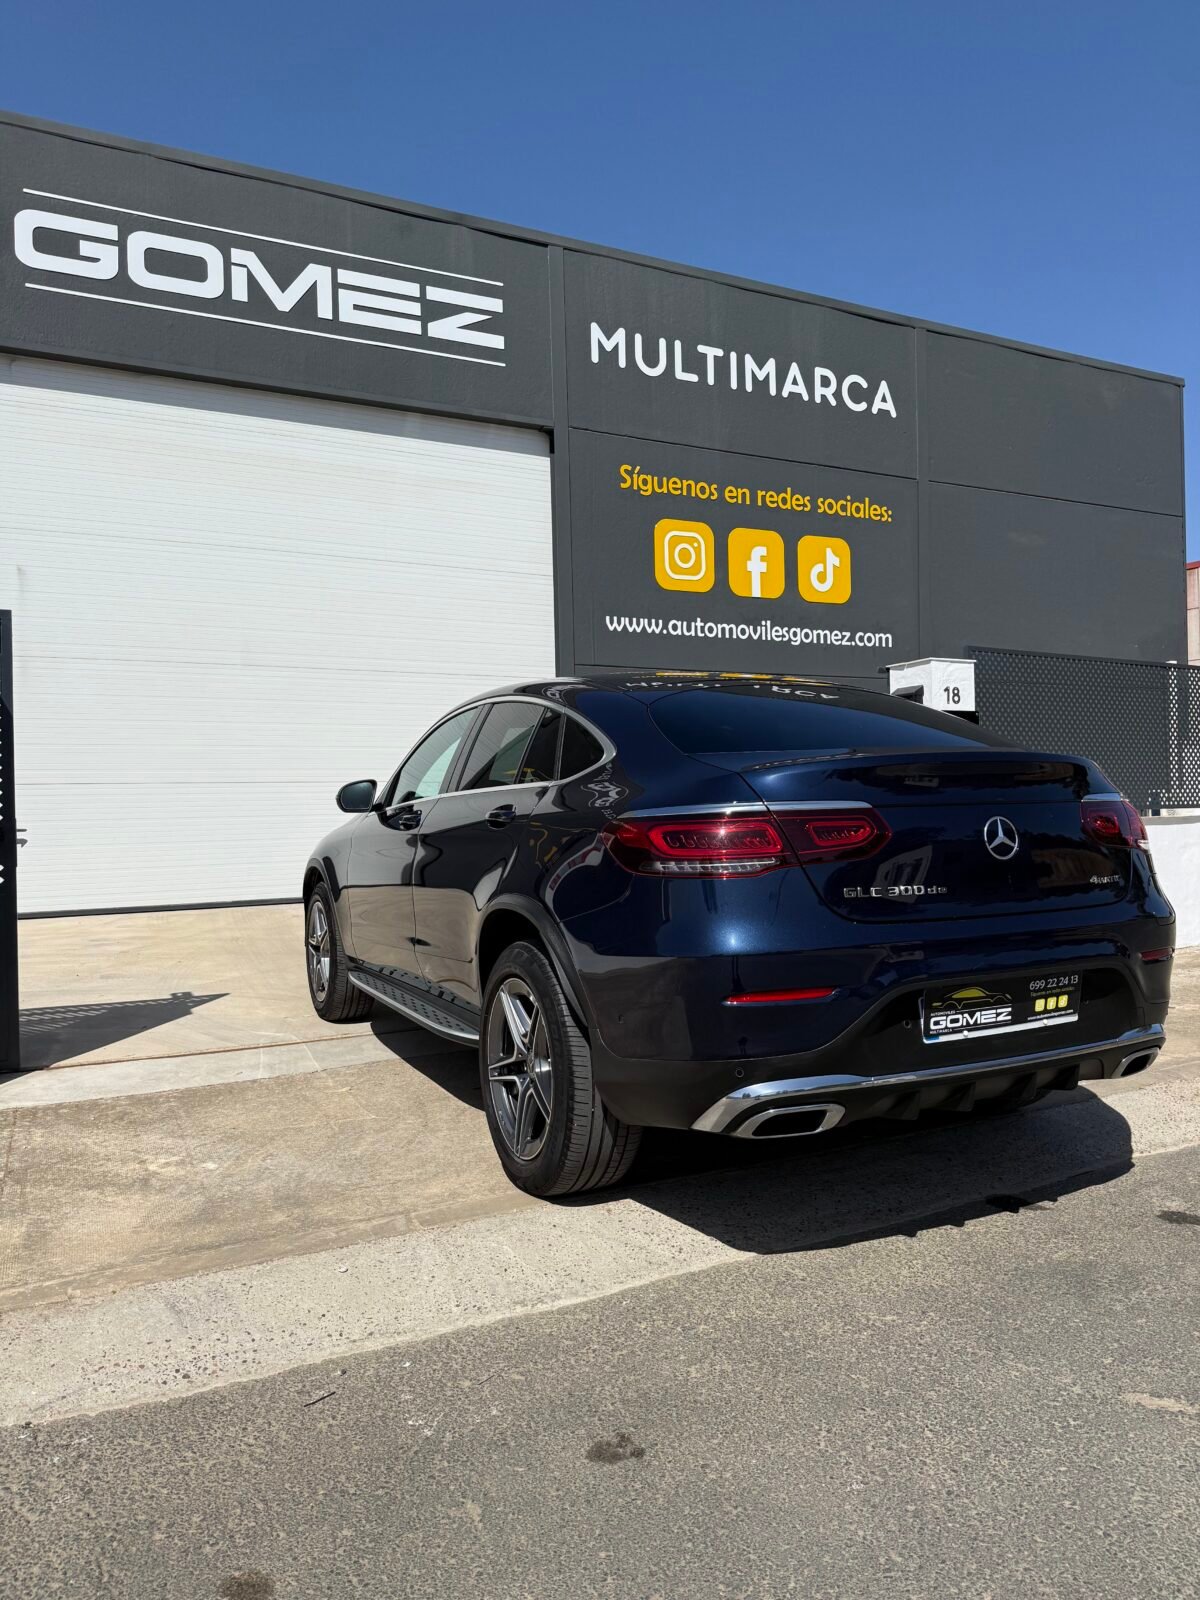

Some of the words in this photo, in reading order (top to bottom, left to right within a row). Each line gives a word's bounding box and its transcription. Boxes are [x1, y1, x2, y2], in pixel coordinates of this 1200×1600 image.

[13, 208, 505, 350] GOMEZ
[590, 321, 897, 419] MULTIMARCA
[619, 464, 718, 500] Síguenos
[724, 485, 751, 505] en
[757, 487, 812, 512] redes
[817, 495, 893, 523] sociales:
[605, 615, 893, 648] www.automovilesgomez.com
[943, 686, 961, 705] 18
[843, 886, 882, 898] GLC
[887, 885, 925, 897] 300
[1029, 979, 1046, 991] 699
[1047, 978, 1057, 988] 22
[1058, 976, 1069, 986] 24
[1070, 974, 1079, 984] 13
[929, 1007, 1012, 1030] GOMEZ
